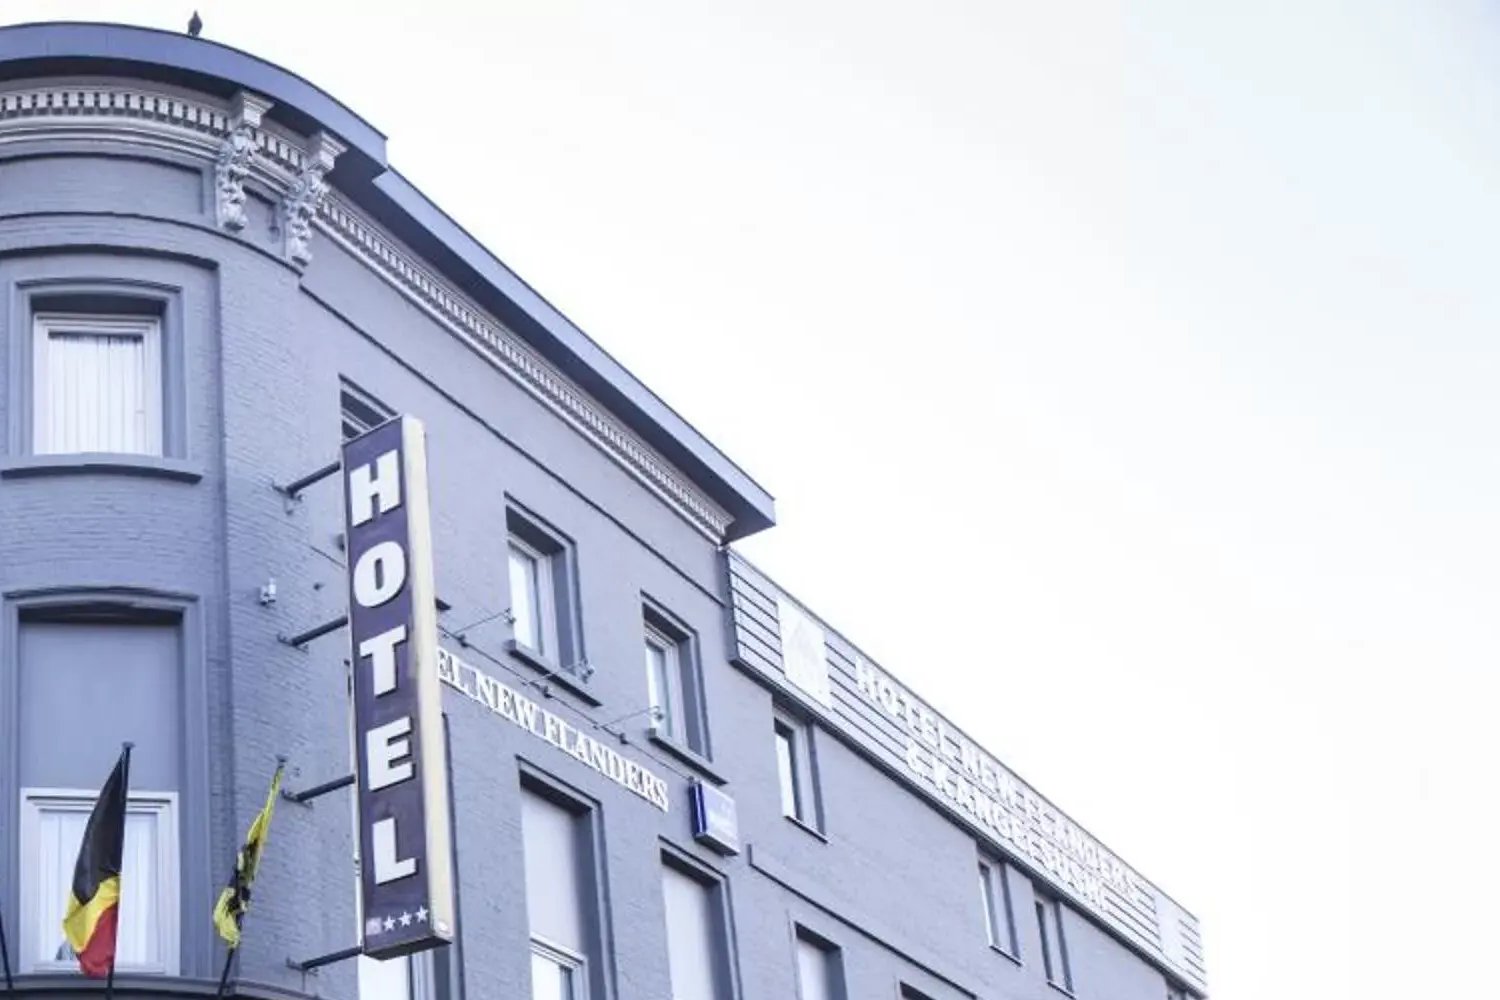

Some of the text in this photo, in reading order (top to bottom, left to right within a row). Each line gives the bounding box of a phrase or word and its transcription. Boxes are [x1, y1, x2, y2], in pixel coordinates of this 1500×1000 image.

[350, 449, 418, 886] HOTEL
[476, 675, 669, 813] NEW FLANDERS
[855, 655, 956, 758] HOTEL
[960, 742, 1017, 808] NEW
